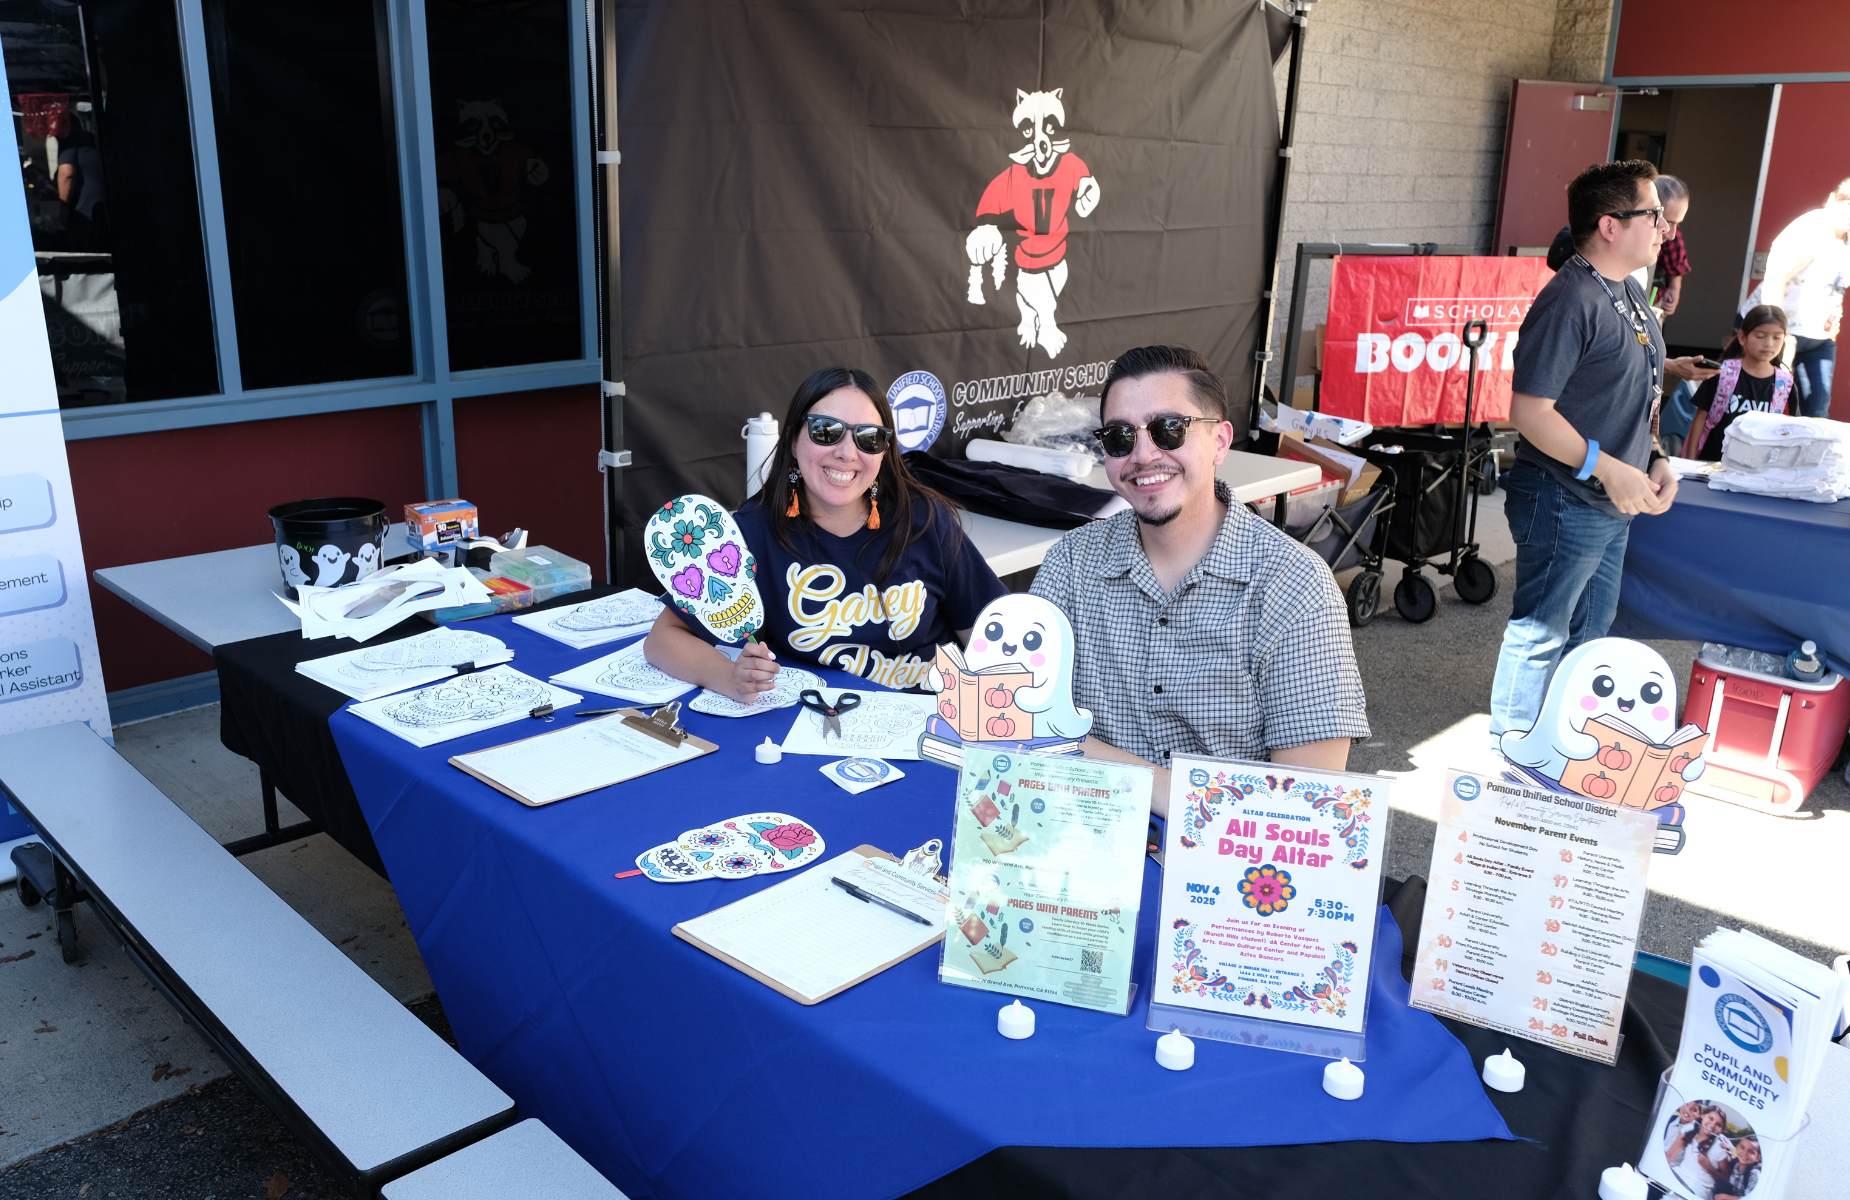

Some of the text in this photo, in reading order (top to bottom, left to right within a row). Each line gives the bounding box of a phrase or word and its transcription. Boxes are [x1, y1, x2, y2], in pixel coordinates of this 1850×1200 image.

[952, 368, 1064, 407] COMMUNITY
[888, 374, 945, 445] UNIFIED SCHOOL DISTRICT
[1738, 400, 1772, 413] AVI
[0, 572, 49, 590] ement
[786, 562, 927, 652] Garey
[0, 665, 32, 680] rker
[818, 643, 933, 690] Vikin
[10, 670, 82, 694] Assistant
[1018, 779, 1110, 800] PAGES WITH PARENTS
[1487, 782, 1521, 797] Pomona
[1523, 789, 1552, 803] Unified
[1554, 795, 1584, 810] School
[1585, 803, 1617, 818] District
[1243, 809, 1311, 822] ALTAR CELEBRATION
[1226, 819, 1331, 847] All Souls
[1458, 831, 1468, 843] 4
[1495, 816, 1537, 832] November
[1539, 827, 1567, 840] Parent
[1569, 833, 1598, 847] Events
[1218, 838, 1334, 868] Day Altar
[1559, 849, 1573, 863] 13
[891, 871, 916, 886] Community
[917, 883, 937, 896] Services
[1451, 880, 1460, 891] 5
[1553, 874, 1569, 888] 17
[1186, 882, 1220, 896] NOV 4
[1190, 896, 1216, 906] 2025
[1315, 899, 1348, 910] 5:30-
[1549, 896, 1564, 910] 17
[1007, 898, 1098, 920] PAGES WITH PARENTS
[1307, 908, 1354, 922] 7:30PM
[1446, 908, 1455, 920] 7
[1212, 924, 1255, 934] Performances
[1266, 931, 1292, 939] Roberto
[1294, 935, 1319, 943] Vasquez
[1273, 924, 1297, 933] Evening
[1544, 920, 1560, 933] 19
[1204, 930, 1225, 938] (Ranch
[1280, 941, 1301, 949] Center
[1437, 934, 1453, 948] 10
[1237, 943, 1262, 951] Cultural
[1264, 946, 1285, 954] Center
[1541, 942, 1558, 956] 20
[1432, 978, 1446, 991] 12
[1536, 970, 1553, 985] 20
[1533, 997, 1548, 1012] 21
[1715, 999, 1727, 1031] POMONA
[1721, 994, 1744, 1005] UNIFIED
[1573, 1031, 1586, 1040] Fall
[1587, 1035, 1609, 1046] Break
[1704, 1043, 1773, 1086] PUPIL AND
[1694, 1053, 1780, 1102] COMMUNITY
[1700, 1070, 1766, 1110] SERVICES
